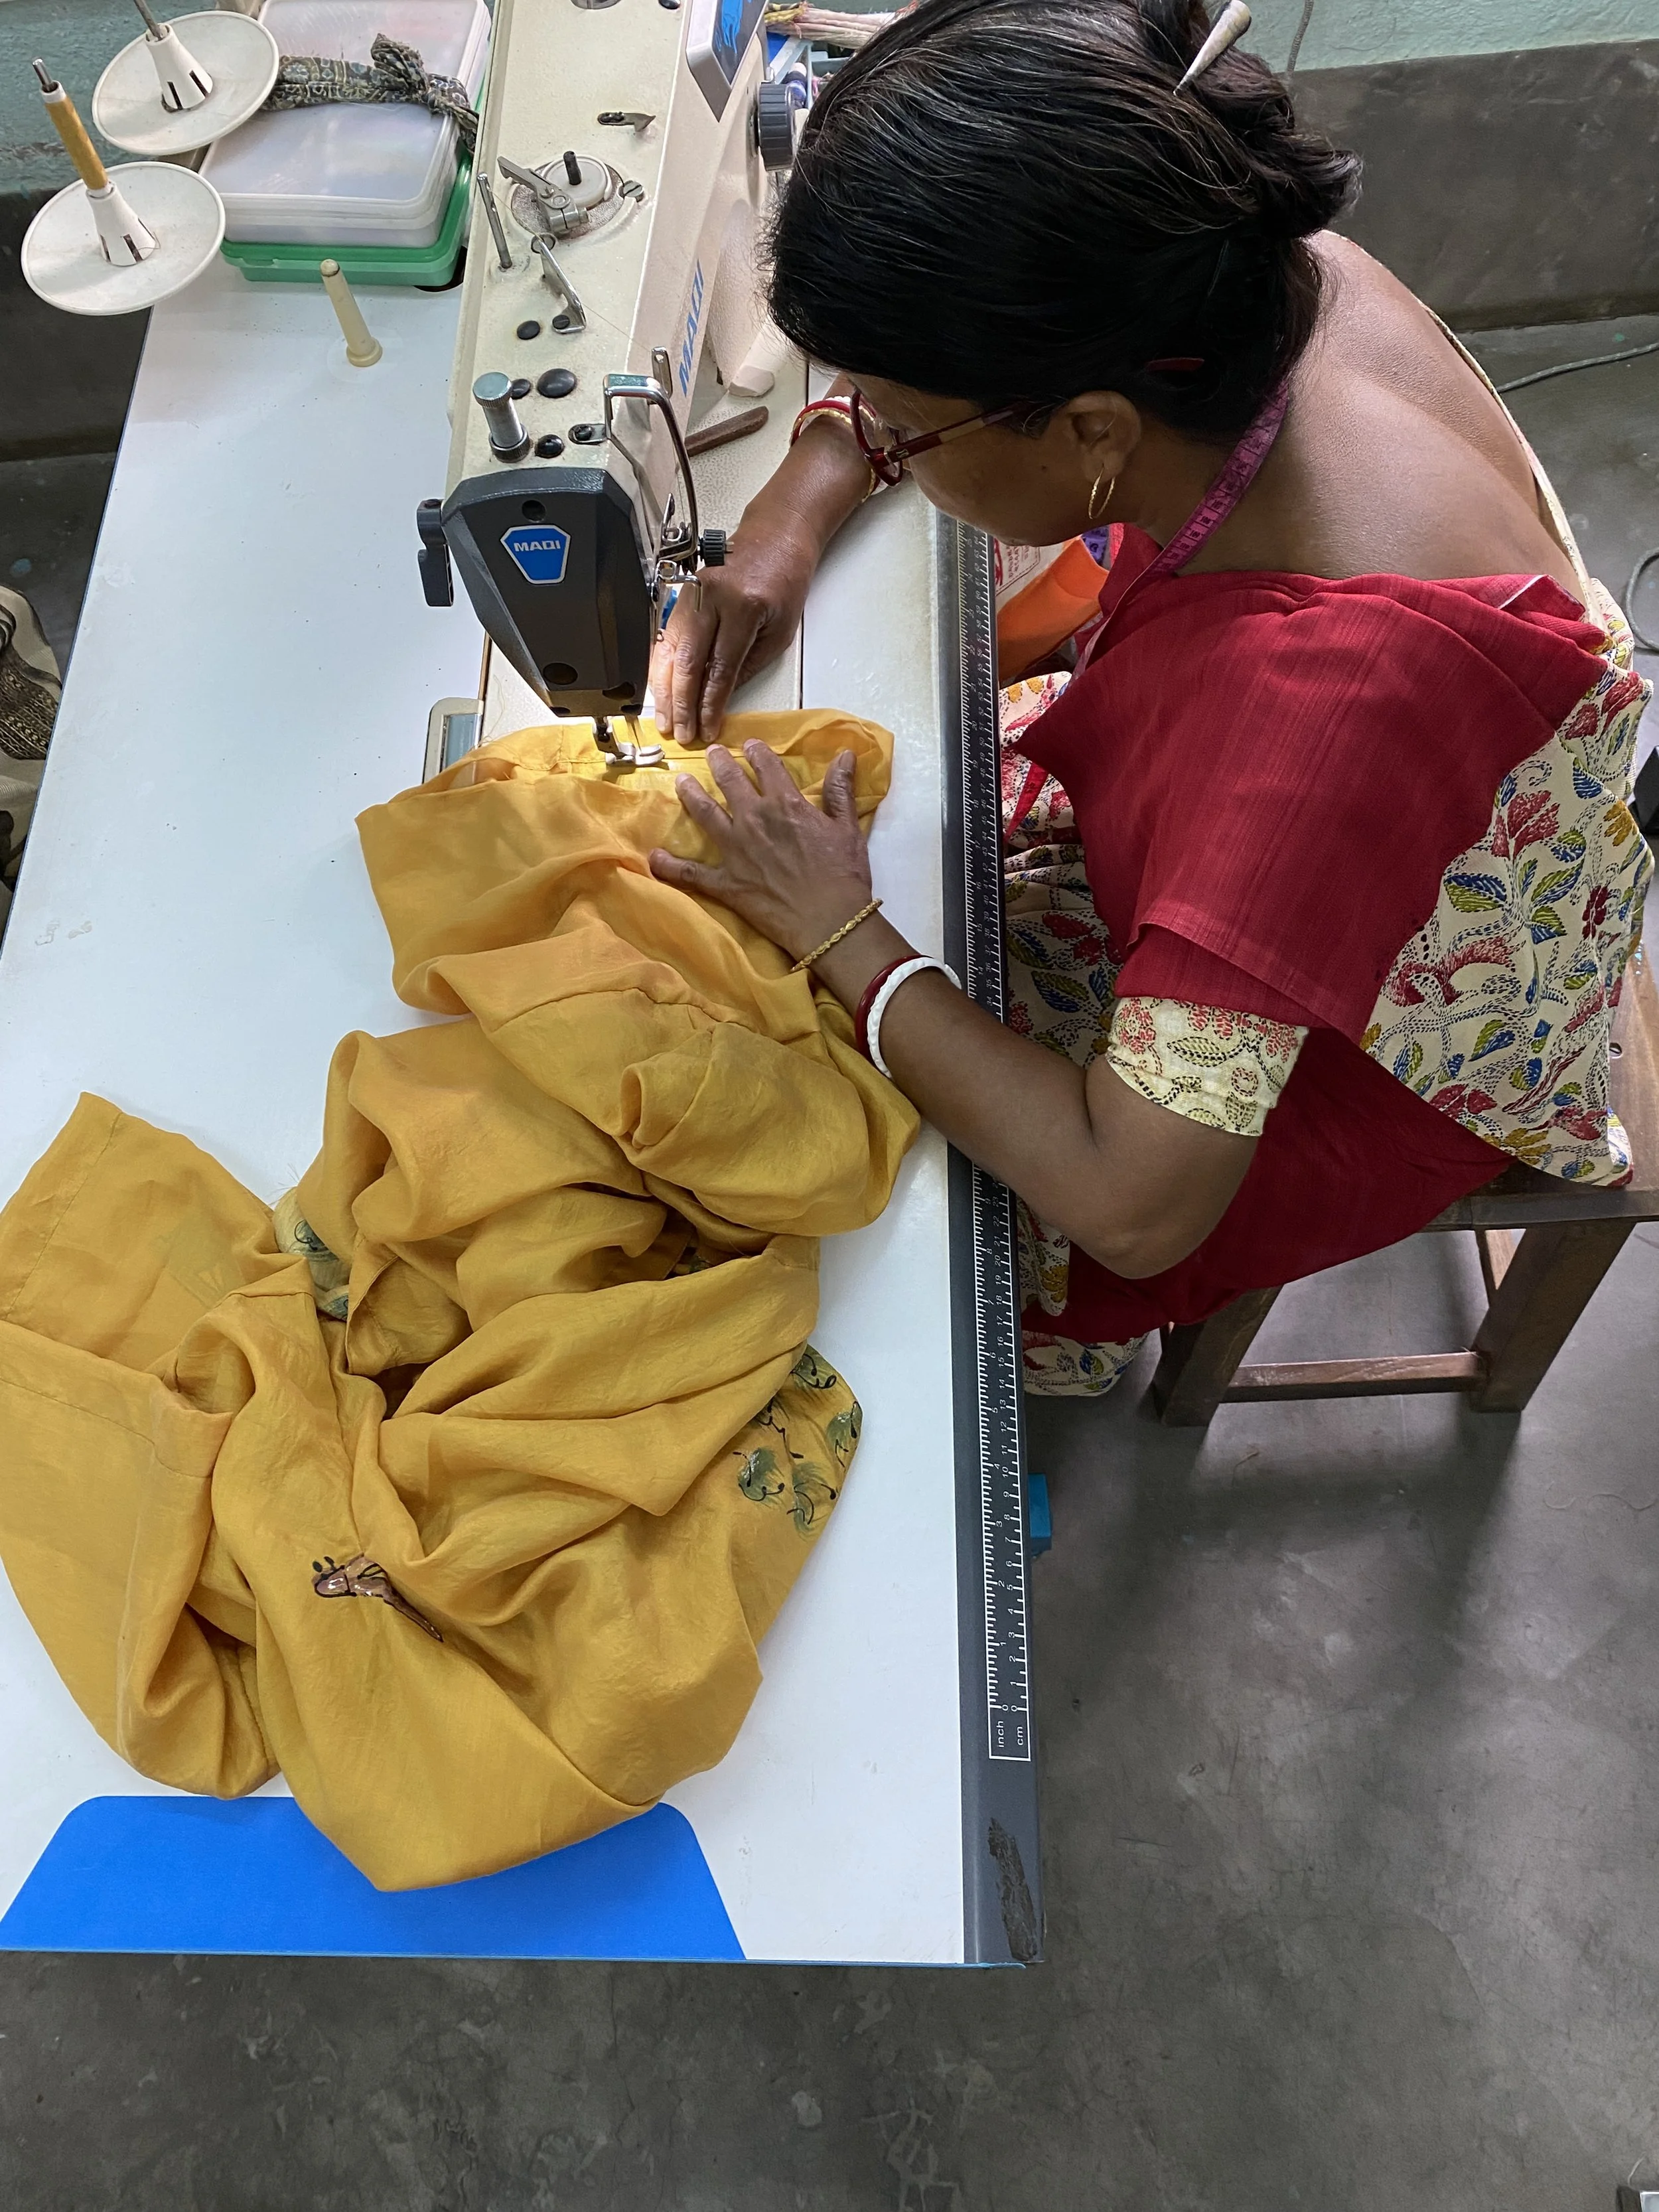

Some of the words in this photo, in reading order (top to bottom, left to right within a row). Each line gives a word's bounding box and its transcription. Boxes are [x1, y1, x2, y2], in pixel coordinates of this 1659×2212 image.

[970, 645, 975, 656] 22
[972, 682, 977, 693] 21
[978, 678, 983, 687] 54
[972, 721, 977, 731] 20
[979, 722, 985, 731] 51
[979, 753, 985, 762] 49
[973, 759, 978, 769] 19
[980, 768, 985, 778] 48
[981, 783, 986, 794] 47
[974, 799, 979, 808] 18
[981, 799, 986, 808] 46
[982, 815, 987, 826] 45
[982, 831, 987, 840] 44
[975, 840, 981, 849] 17
[982, 846, 987, 856] 43
[983, 863, 988, 873] 42
[983, 879, 989, 889] 41
[984, 895, 989, 905] 40
[983, 911, 990, 921] 39
[977, 922, 982, 932] 15
[985, 928, 990, 938] 38
[985, 945, 991, 956] 37
[978, 966, 983, 976] 14
[986, 962, 991, 972] 36
[986, 978, 992, 989] 35
[987, 996, 993, 1006] 34
[993, 1196, 999, 1208] 23
[993, 1216, 999, 1226] 22
[994, 1236, 1000, 1246] 21
[995, 1254, 1001, 1266] 20
[995, 1274, 1001, 1285] 19
[996, 1295, 1002, 1305] 18
[997, 1315, 1003, 1326] 17
[997, 1336, 1003, 1346] 16
[998, 1357, 1005, 1367] 15
[999, 1379, 1005, 1389] 14
[999, 1399, 1006, 1410] 13
[1001, 1422, 1007, 1432] 12
[1001, 1445, 1007, 1455] 11
[1002, 1467, 1009, 1477] 10
[1017, 1726, 1023, 1745] cm
